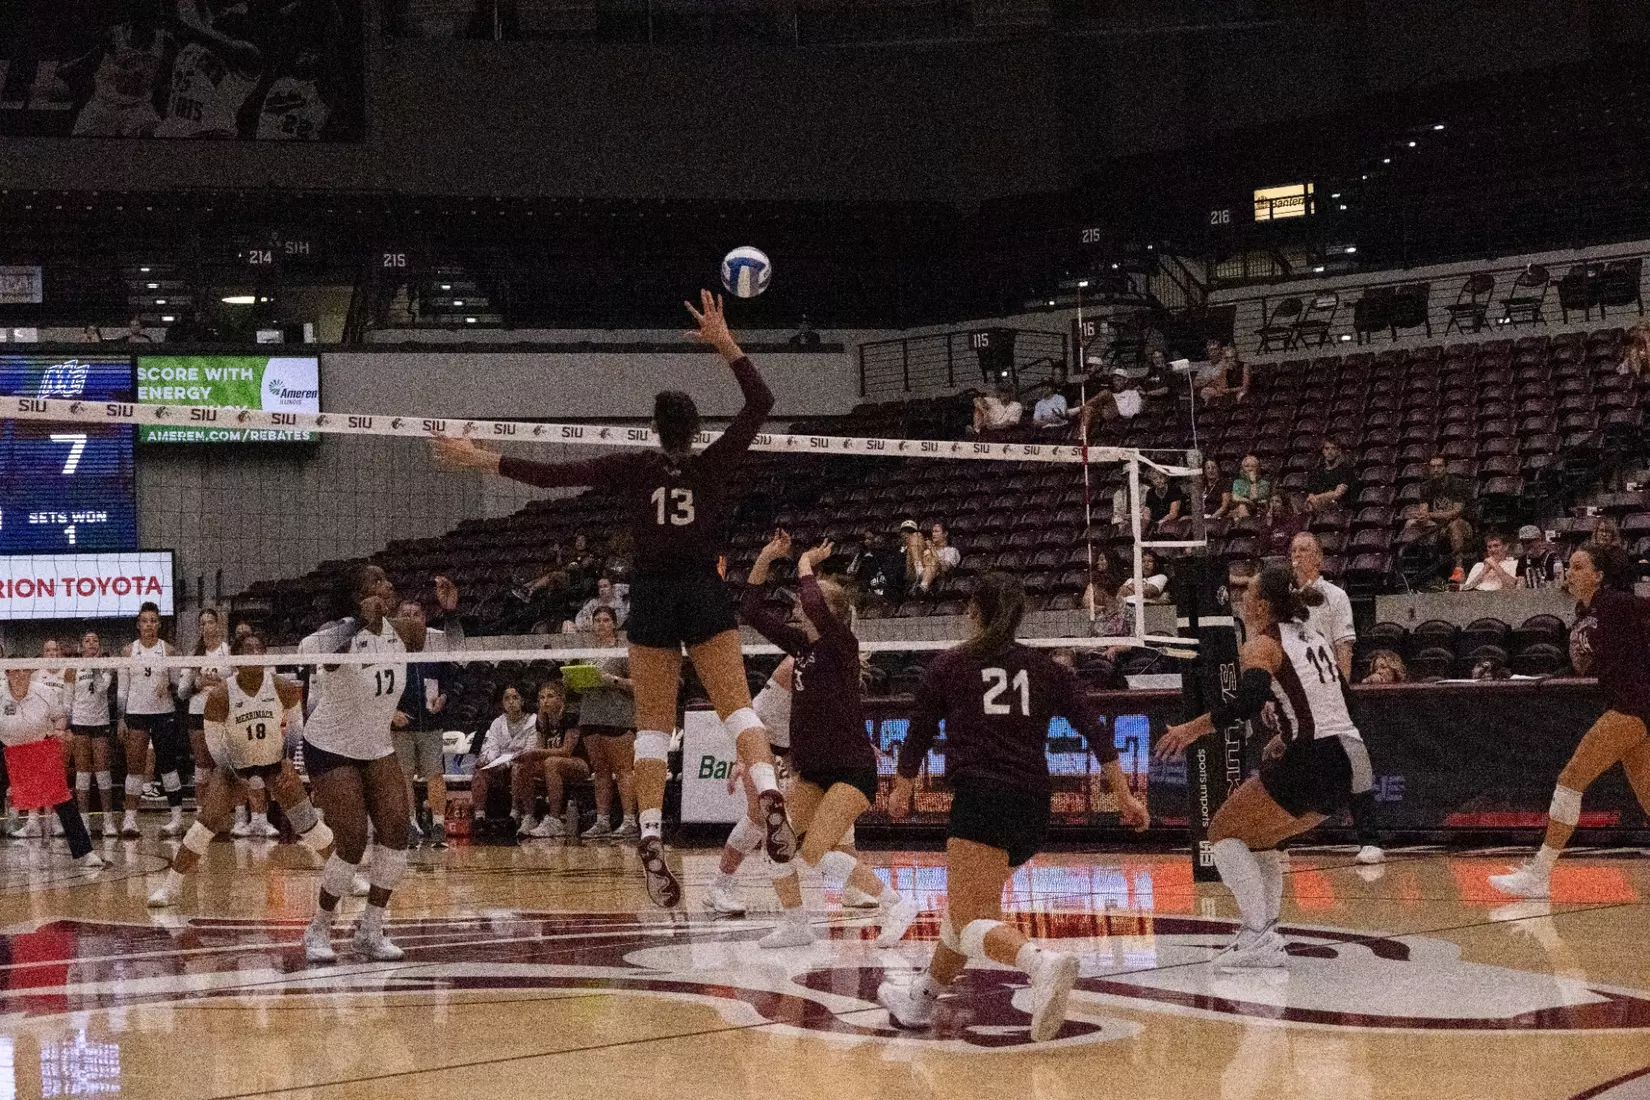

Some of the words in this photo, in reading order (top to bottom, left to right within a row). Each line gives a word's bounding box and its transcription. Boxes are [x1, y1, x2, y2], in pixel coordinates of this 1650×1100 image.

[1210, 209, 1230, 225] 216
[1082, 228, 1100, 243] 215
[249, 250, 272, 264] 214
[383, 253, 406, 267] 215
[973, 332, 989, 348] 115
[137, 367, 199, 381] SCORE
[204, 367, 254, 381] WITH
[137, 386, 212, 400] ENERGY
[279, 387, 318, 399] Ameren
[18, 399, 47, 412] SIU
[106, 404, 134, 417] SIU
[190, 408, 217, 421] SIU
[270, 412, 297, 425] SIU
[348, 416, 373, 429] SIU
[422, 419, 446, 432] SIU
[493, 422, 516, 435] SIU
[561, 426, 584, 439] SIU
[627, 429, 648, 441] SIU
[810, 437, 829, 448] SIU
[866, 439, 885, 450] SIU
[921, 441, 939, 452] SIU
[973, 443, 990, 454] SIU
[1023, 444, 1040, 456] SIU
[147, 430, 310, 442] AMEREN.COM/REBATES
[50, 434, 87, 474] 7
[651, 486, 695, 526] 13
[29, 511, 68, 524] SETS
[71, 511, 107, 523] WON
[64, 525, 76, 545] 1
[61, 575, 163, 597] TOYOTA
[1305, 645, 1336, 684] 11
[374, 669, 395, 697] 17
[981, 666, 1030, 717] 21
[235, 709, 275, 725] MERRIMACK
[245, 722, 266, 741] 18
[1198, 749, 1208, 784] sports
[1201, 785, 1210, 828] imports
